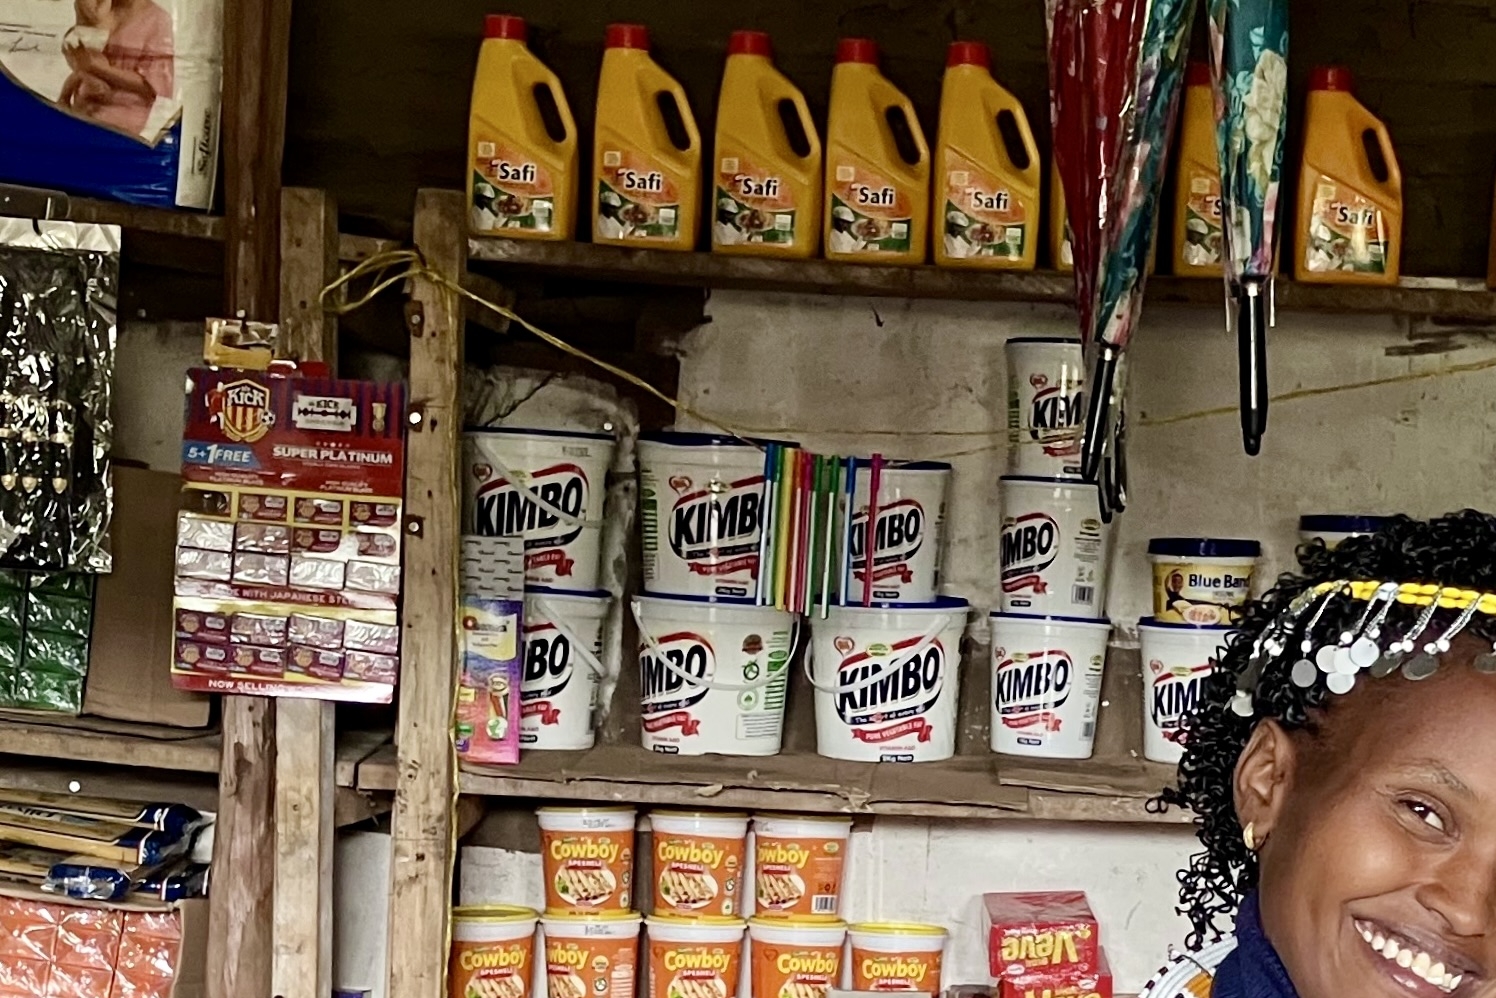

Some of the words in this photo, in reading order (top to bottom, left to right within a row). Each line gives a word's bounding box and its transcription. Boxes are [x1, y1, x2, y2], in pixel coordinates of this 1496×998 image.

[499, 162, 535, 182] Safi
[625, 171, 662, 191] Safi
[742, 178, 779, 197] Safi
[859, 186, 895, 206] Safi
[972, 191, 1008, 210] Safi
[1338, 206, 1373, 226] Safi
[226, 387, 266, 407] KICK
[1033, 391, 1083, 429] KIM
[273, 446, 318, 460] SUPER
[320, 449, 393, 464] PLATINUM
[477, 476, 584, 537] KIMBO
[1001, 520, 1054, 569] IMBO
[1188, 572, 1220, 588] Blue
[242, 588, 267, 599] WITH
[270, 591, 327, 604] JAPANESE
[640, 643, 708, 698] IMBO
[839, 646, 940, 716] KIMBO
[997, 658, 1069, 706] KIMBO
[209, 679, 234, 689] NOW
[1153, 677, 1201, 717] KIM
[551, 840, 619, 863] Cowboy
[659, 842, 723, 868] Cowboy
[759, 843, 810, 868] owboy
[1001, 931, 1079, 964] Veve
[460, 949, 526, 971] Cowboy
[664, 950, 730, 973] Cowboy
[862, 957, 927, 982] Cowboy
